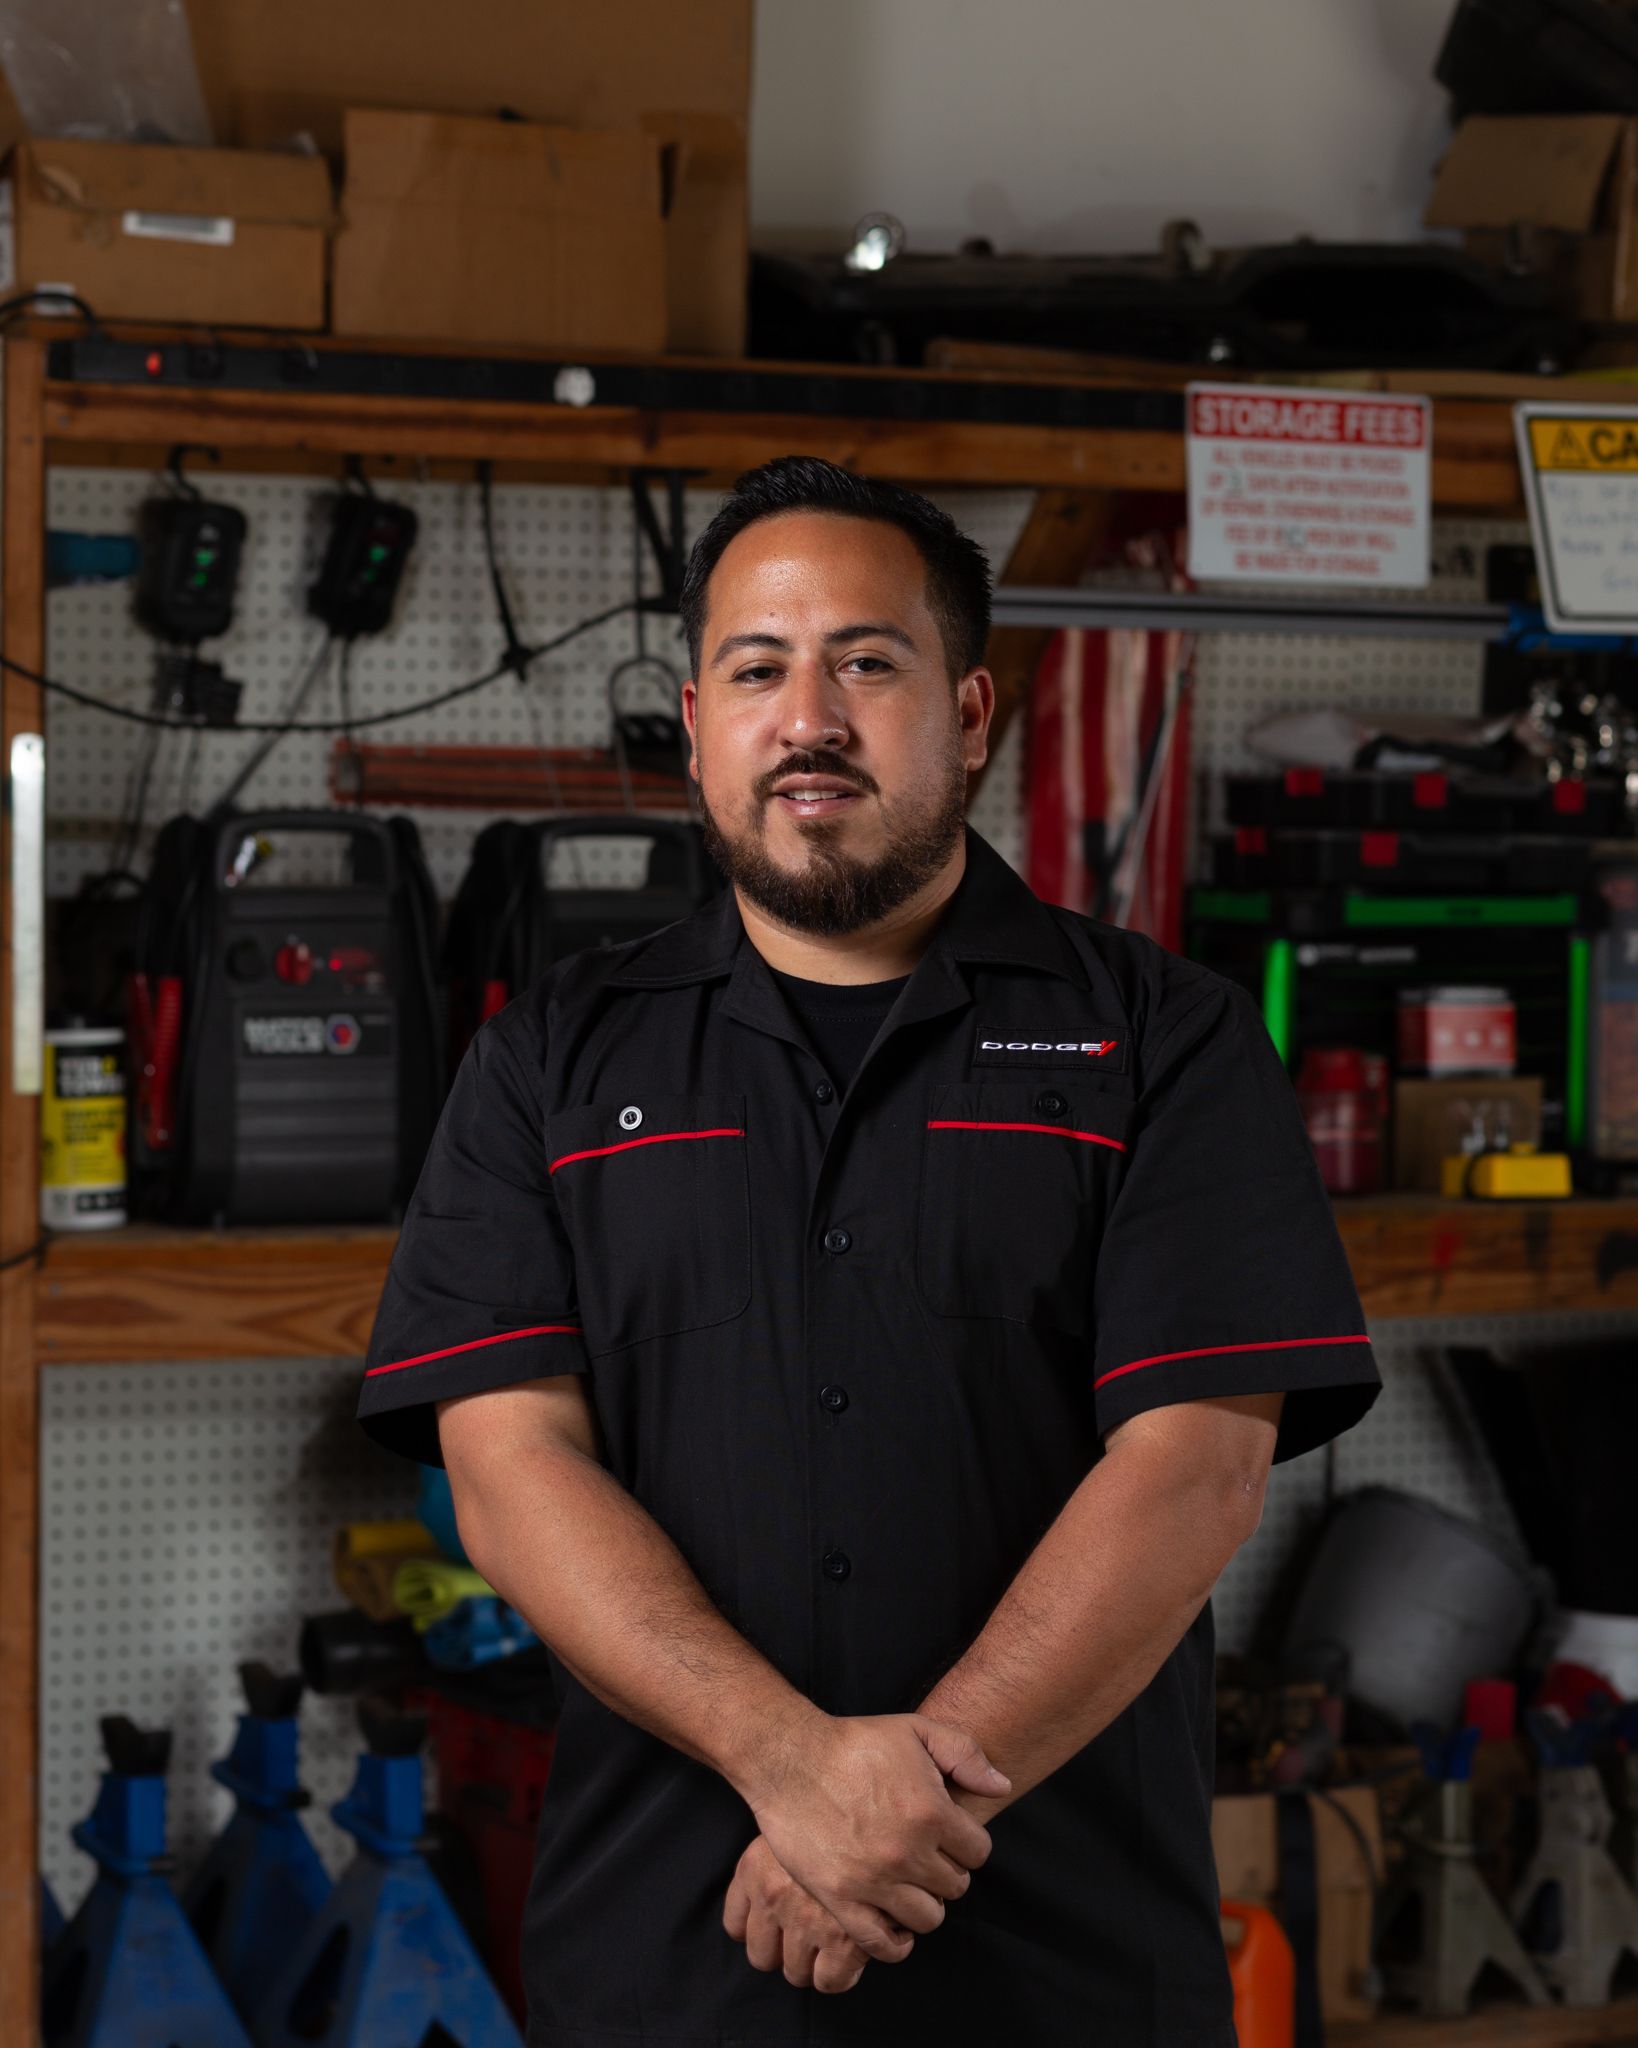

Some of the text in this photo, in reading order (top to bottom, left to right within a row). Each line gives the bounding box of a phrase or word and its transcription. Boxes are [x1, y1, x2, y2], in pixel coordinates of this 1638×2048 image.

[1198, 398, 1421, 444] STORAGE FEES
[981, 1041, 1103, 1052] DODGE
